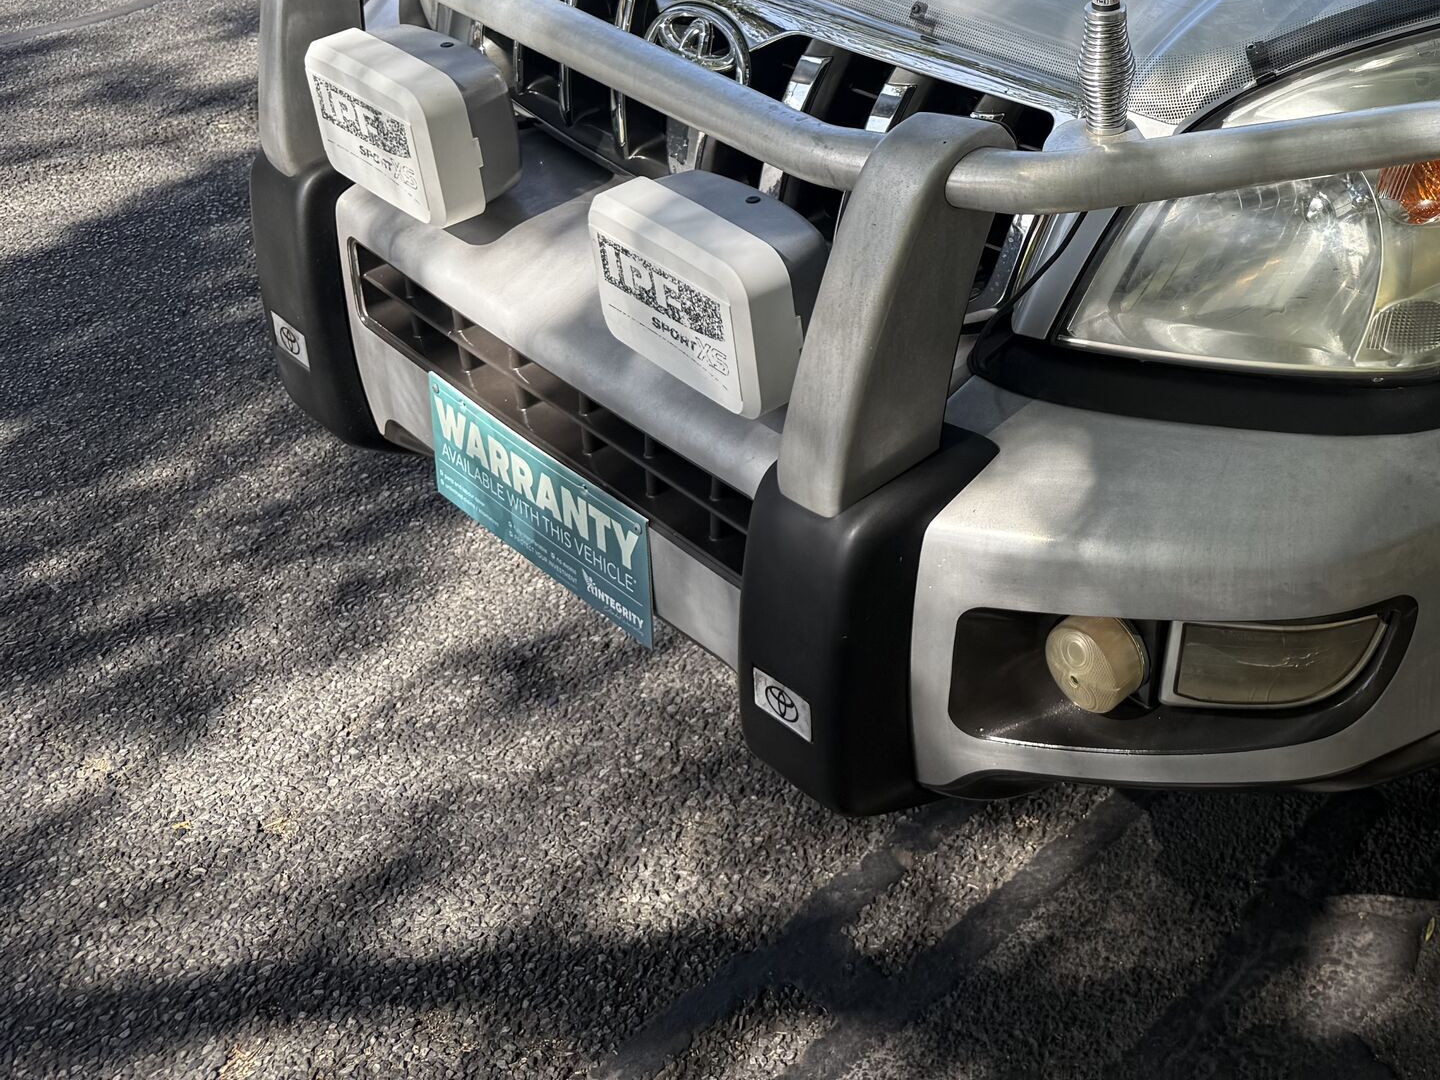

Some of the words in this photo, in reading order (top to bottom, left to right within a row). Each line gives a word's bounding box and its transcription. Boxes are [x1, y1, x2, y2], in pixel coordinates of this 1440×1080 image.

[434, 397, 641, 570] WARRANTY
[441, 445, 505, 501] AVAILABLE
[506, 489, 539, 526] WITH
[542, 516, 572, 548] THIS
[594, 584, 643, 631] INTEGRITY
